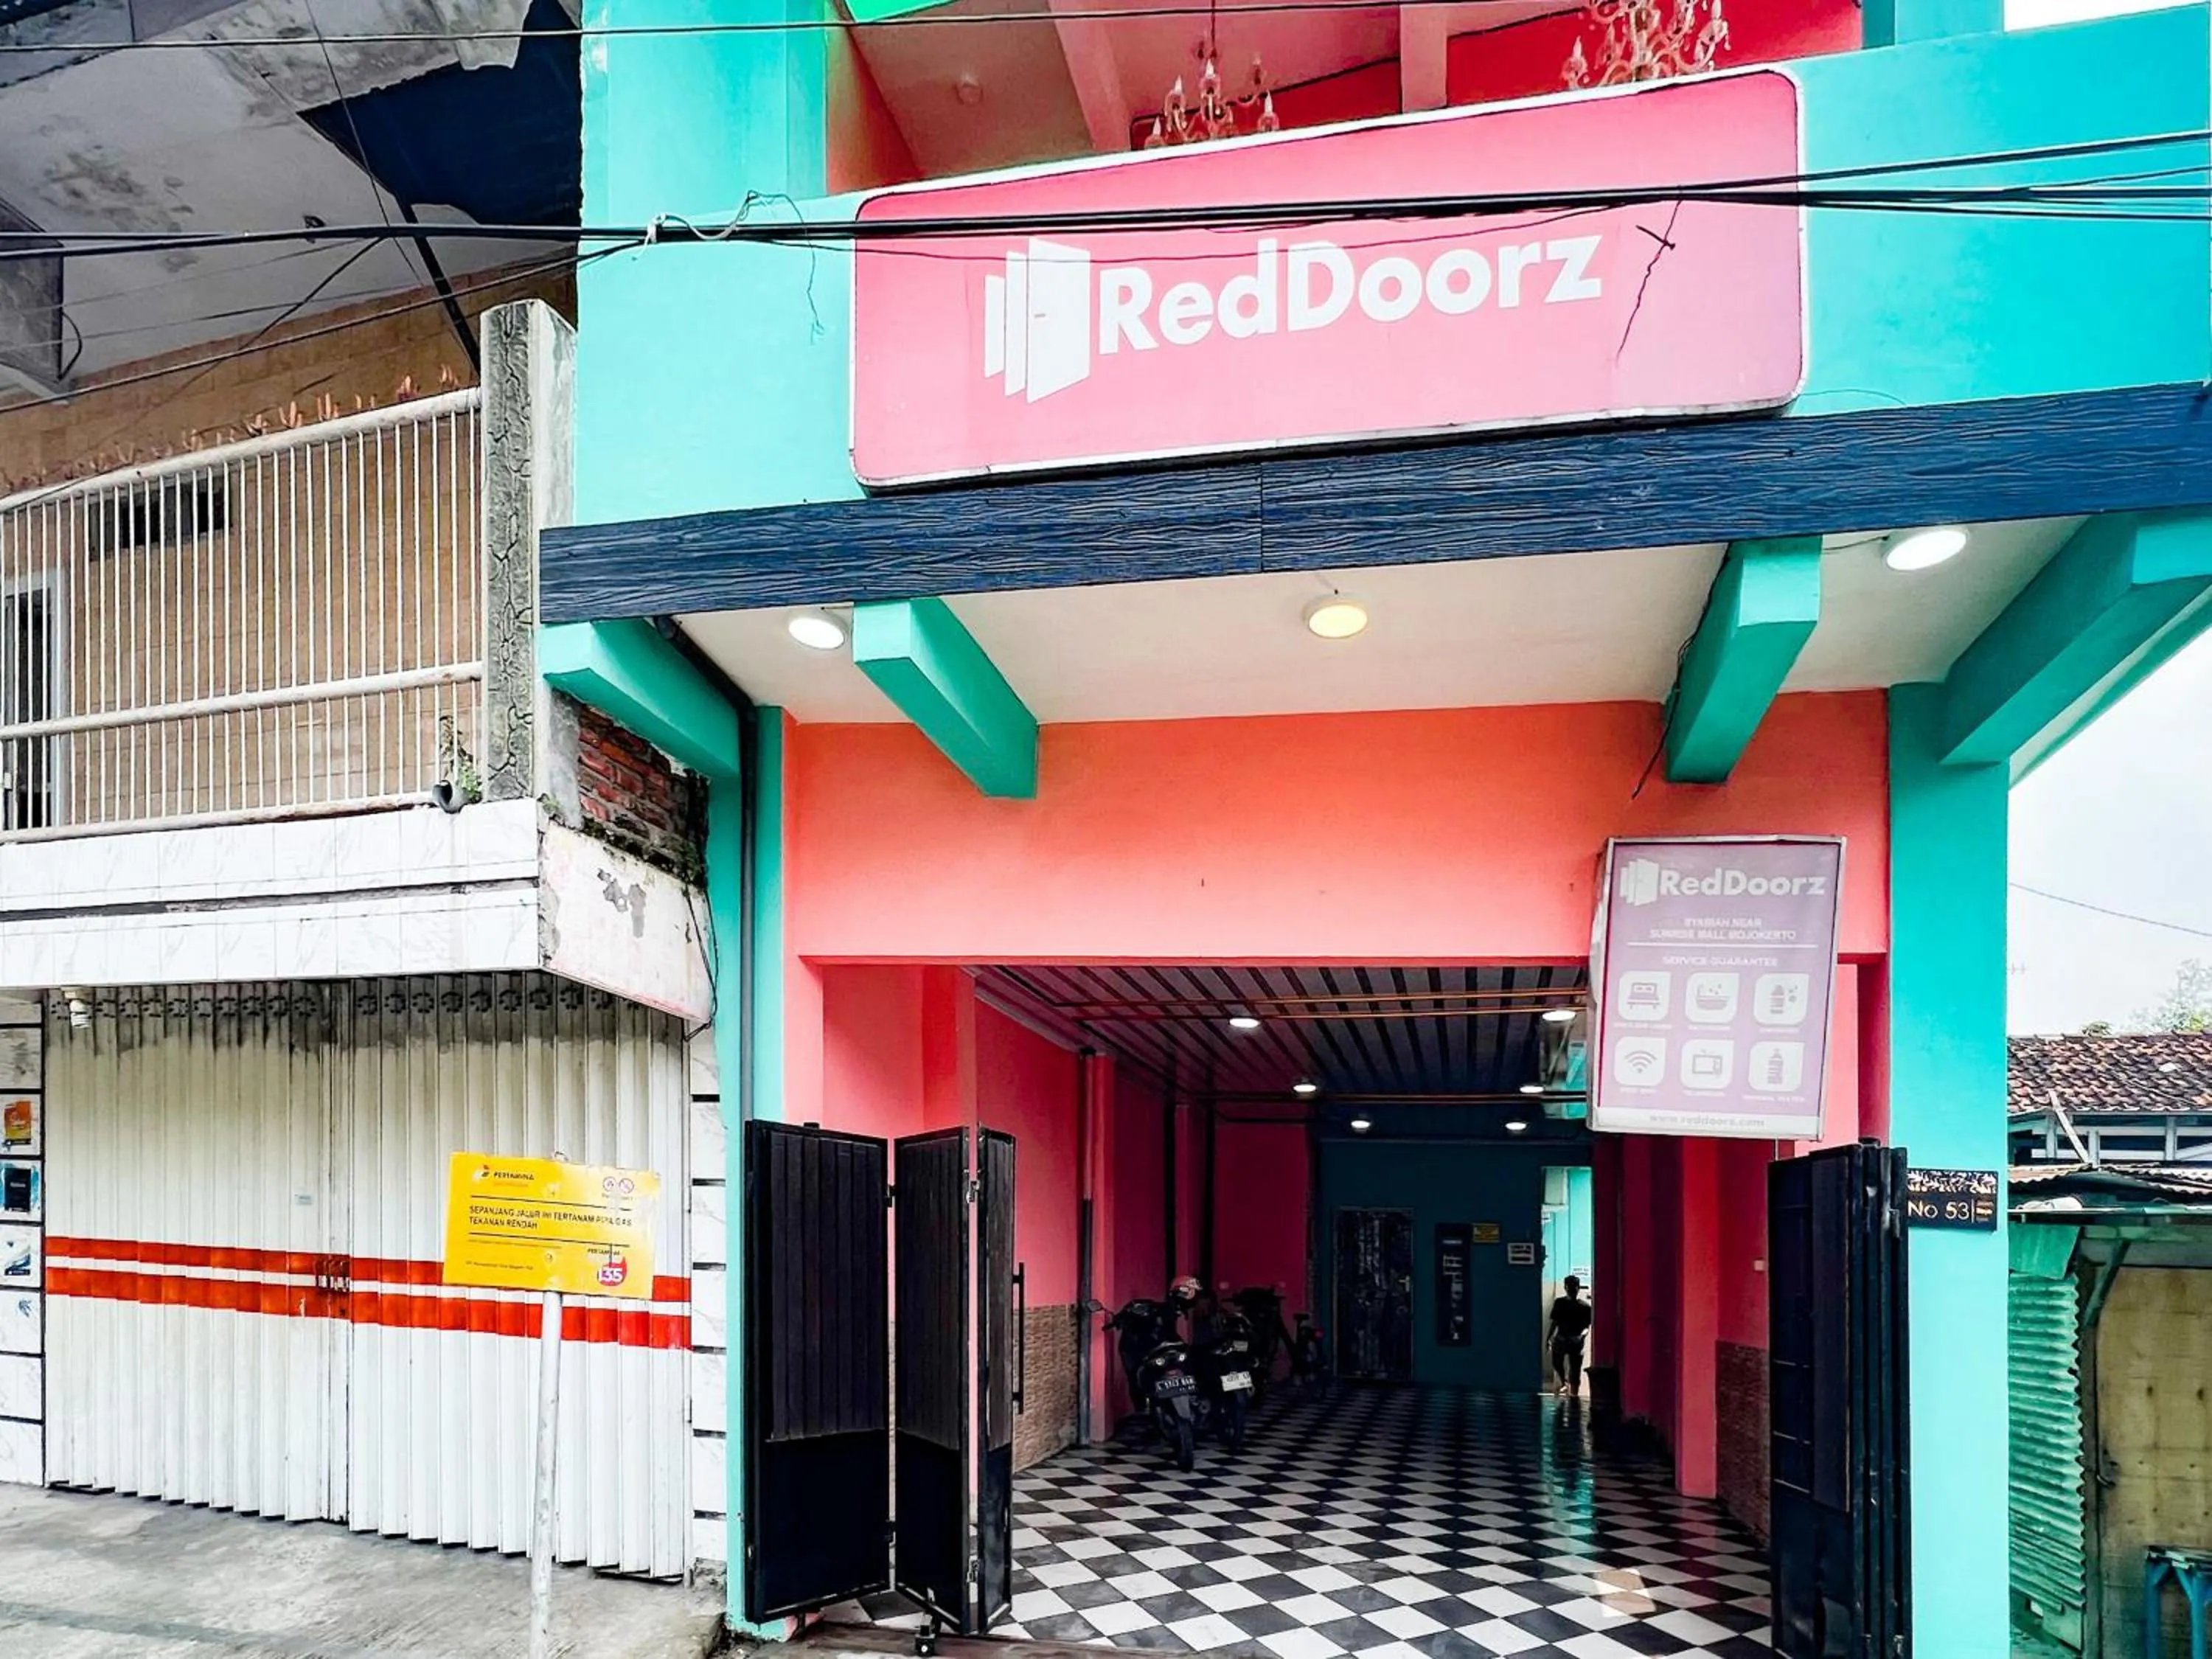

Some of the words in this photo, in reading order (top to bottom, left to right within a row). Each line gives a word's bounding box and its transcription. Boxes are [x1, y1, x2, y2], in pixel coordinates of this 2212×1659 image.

[1099, 235, 1602, 355] RedDoorz
[1660, 867, 1827, 897] RedDoorz
[1697, 930, 1726, 940] MALL
[493, 1171, 535, 1180] PERTAMINA
[469, 1206, 515, 1217] SEPANJANG
[516, 1209, 540, 1218] JALUR
[554, 1211, 595, 1222] TERTANAM
[1907, 1200, 1938, 1218] No
[1944, 1201, 1969, 1220] 53
[469, 1216, 505, 1226] TEKANAN
[507, 1219, 538, 1229] RENDAH
[598, 1267, 624, 1282] 135
